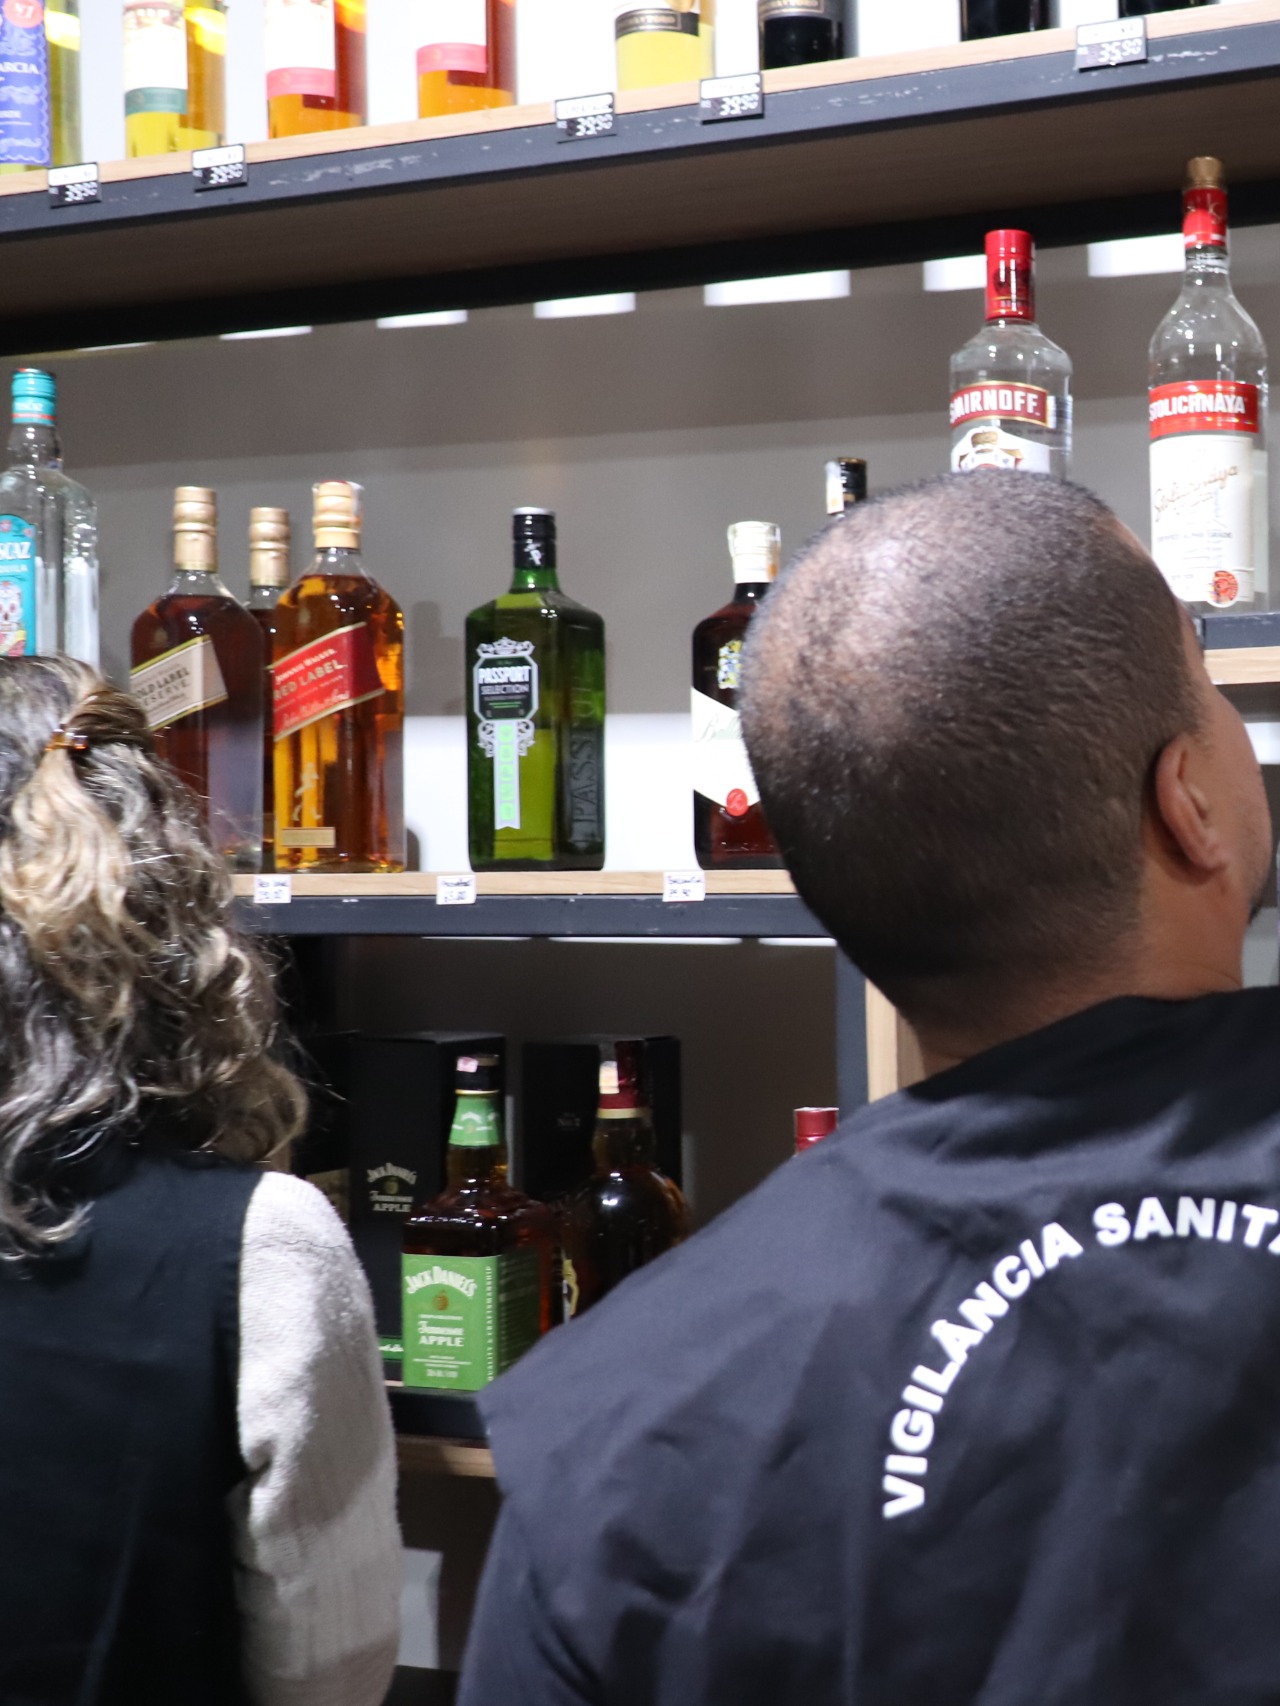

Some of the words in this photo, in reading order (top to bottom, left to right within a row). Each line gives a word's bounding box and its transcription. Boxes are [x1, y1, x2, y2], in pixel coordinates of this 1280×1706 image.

[949, 388, 1039, 424] SMIRNOFF
[1149, 392, 1246, 422] STOLICHNAYA
[479, 666, 532, 685] PASSPORT
[143, 679, 190, 707] ESERVE
[481, 684, 529, 696] SELECTION
[373, 1202, 412, 1213] APPLE
[418, 1335, 465, 1347] APPLE
[882, 1221, 1084, 1519] VIGILÂNCIA
